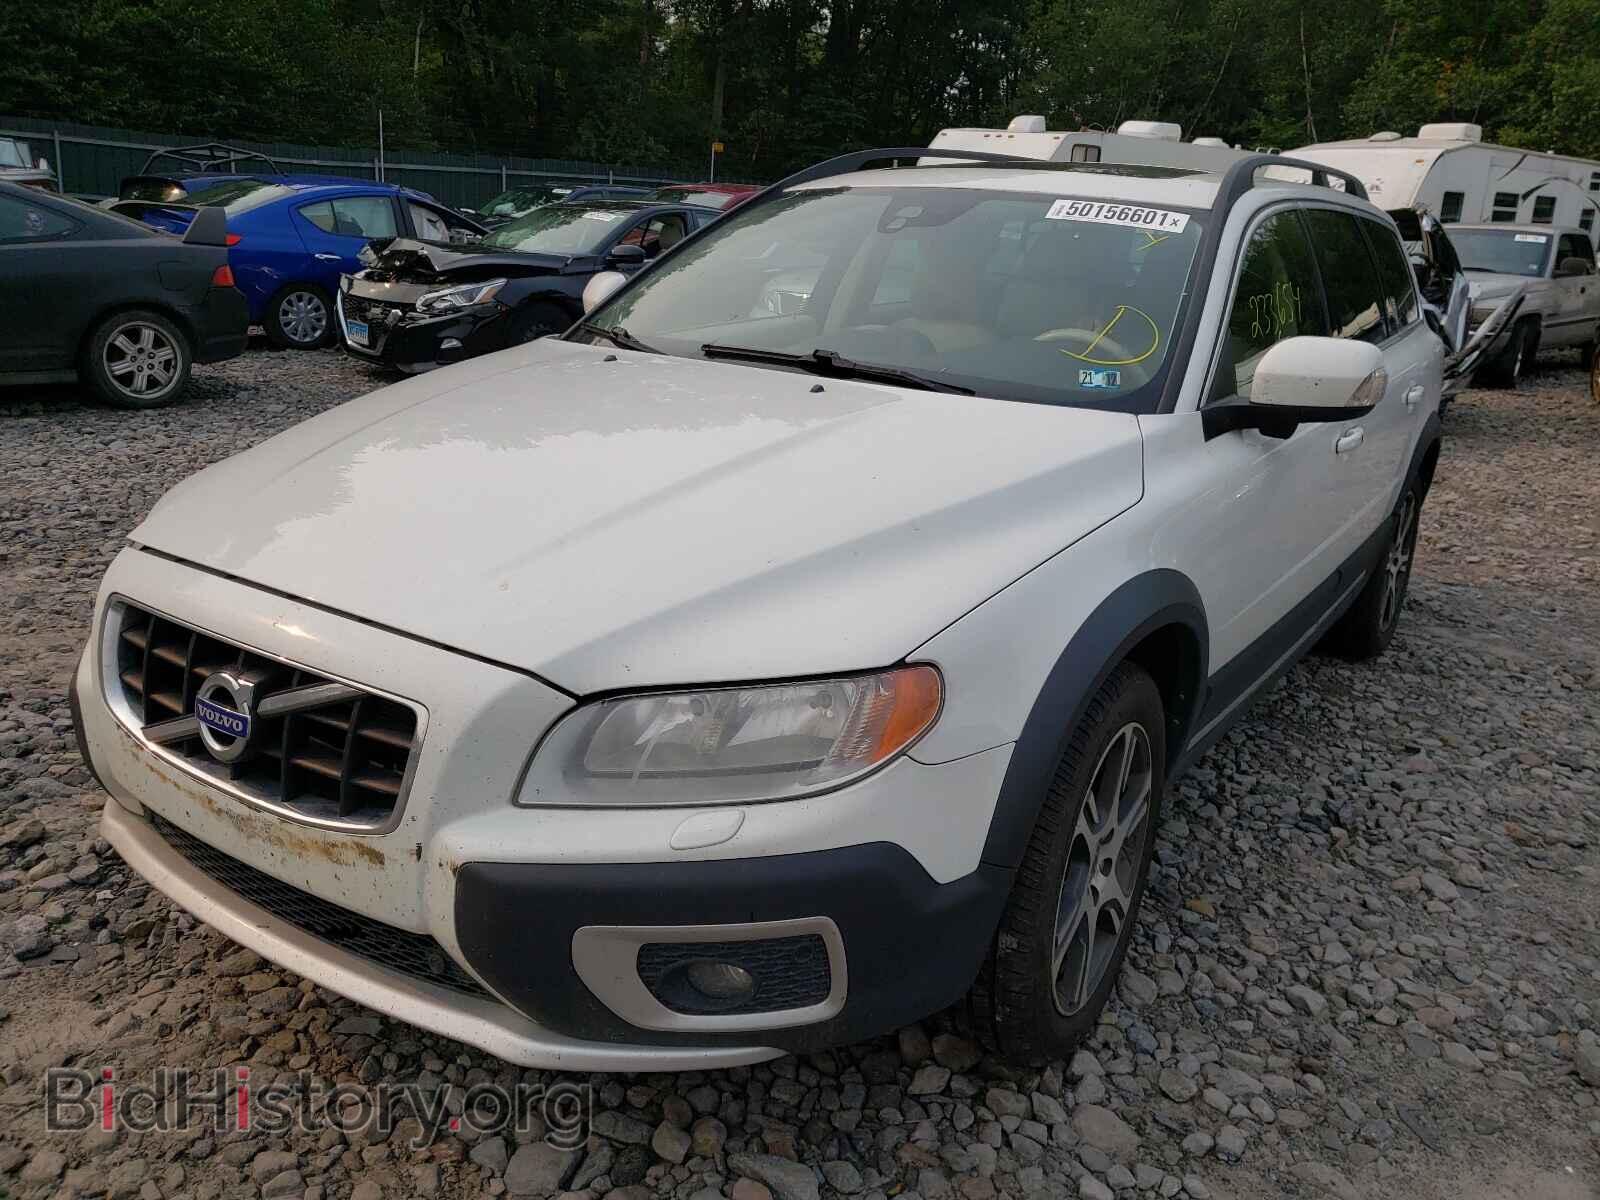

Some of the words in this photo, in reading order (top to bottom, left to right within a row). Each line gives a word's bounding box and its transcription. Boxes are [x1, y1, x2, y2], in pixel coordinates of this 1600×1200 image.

[1065, 201, 1169, 227] 50156601
[1058, 304, 1159, 365] D
[1081, 371, 1093, 385] 21
[197, 703, 243, 732] VOLVO
